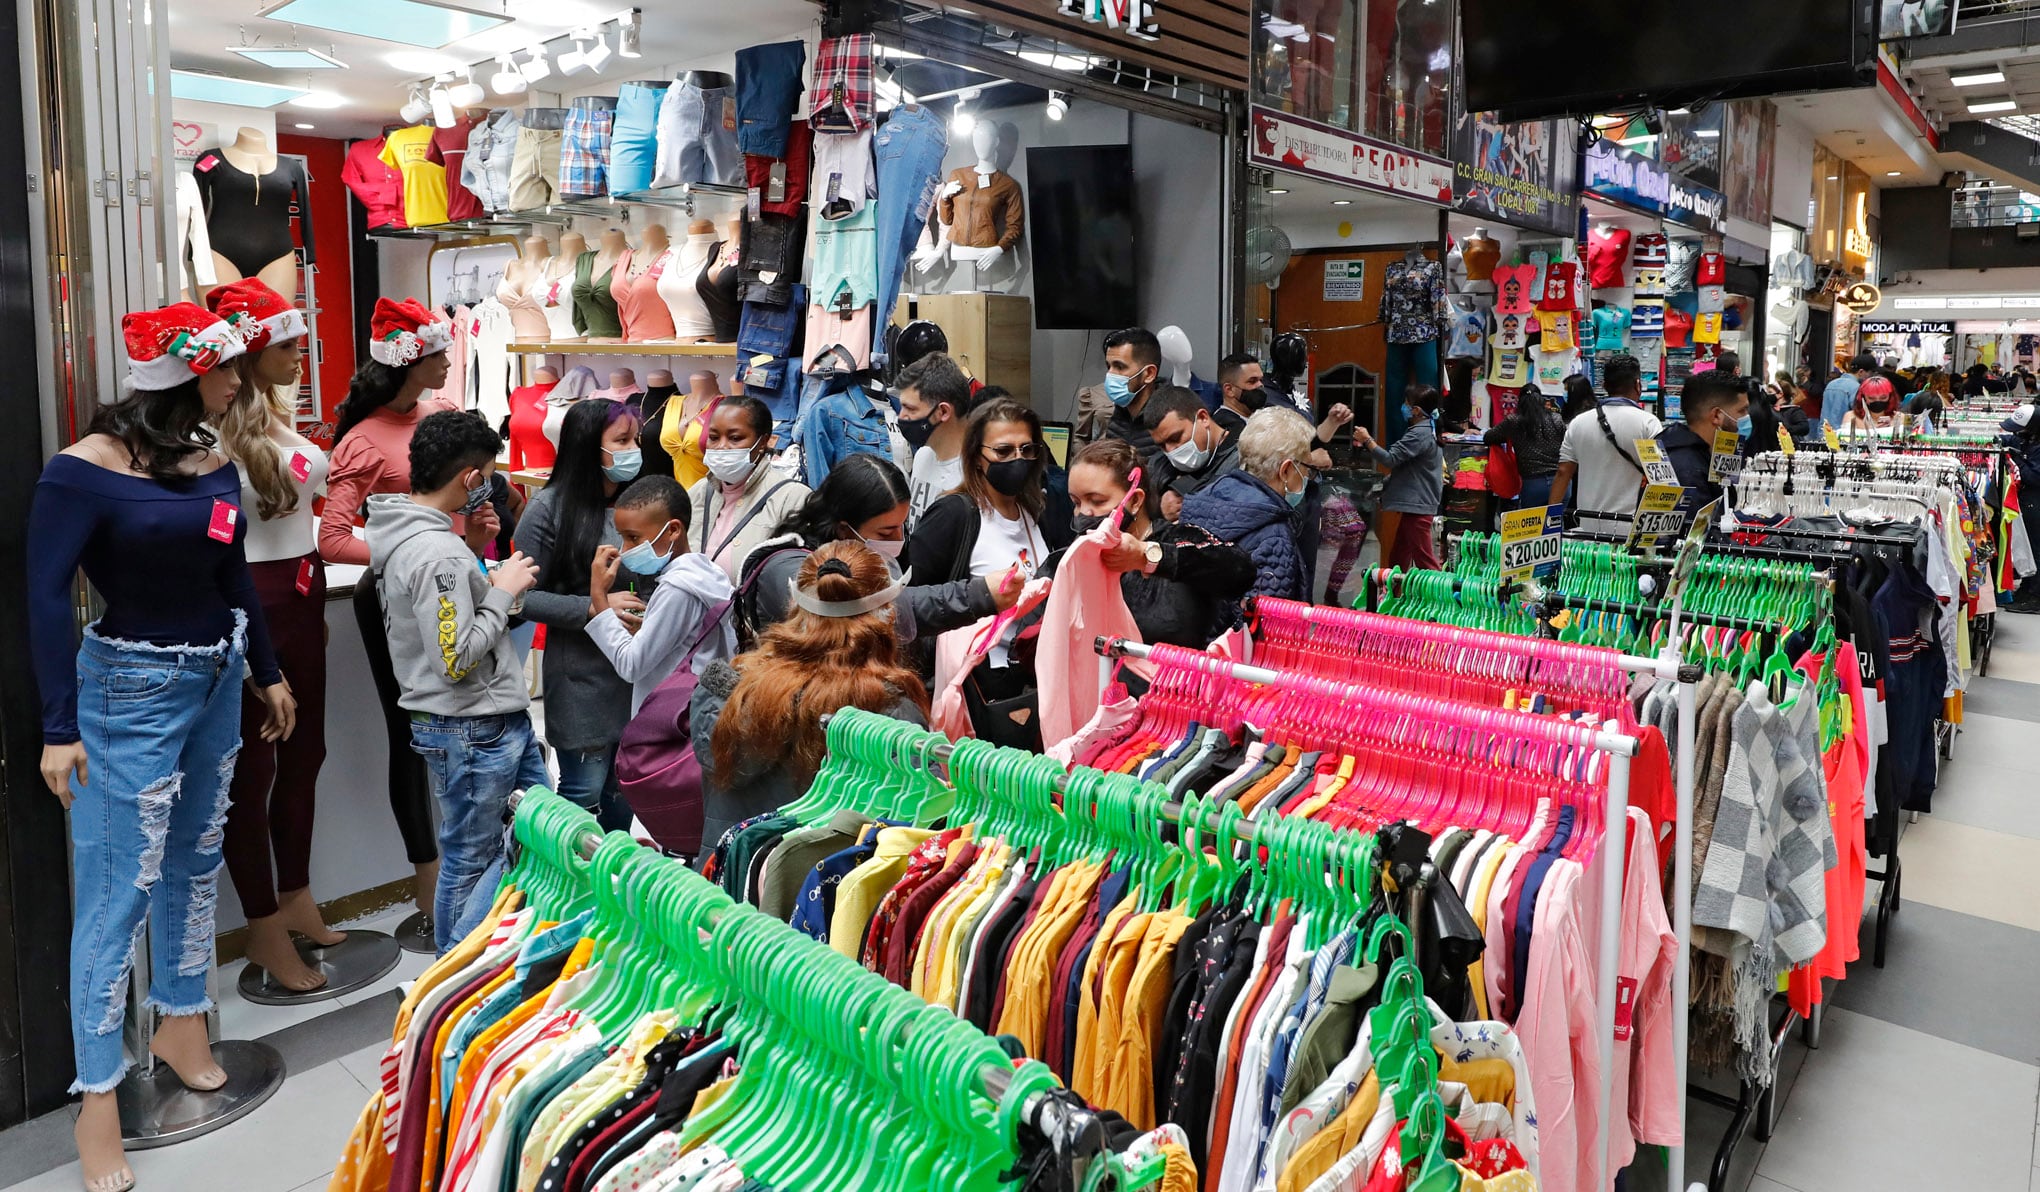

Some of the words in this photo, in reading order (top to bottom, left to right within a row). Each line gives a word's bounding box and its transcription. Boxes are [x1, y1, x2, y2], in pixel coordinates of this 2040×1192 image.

[1285, 135, 1347, 163] DISTRIBUIDORA
[1457, 162, 1472, 179] C.C.
[1473, 167, 1493, 185] GRAN
[1495, 174, 1508, 189] SAN
[1509, 178, 1538, 197] CARRERA
[1540, 188, 1547, 200] 10
[1564, 194, 1571, 207] 37
[1497, 191, 1522, 212] LOCAL
[1524, 199, 1539, 215] 1081
[1862, 323, 1895, 333] MODA
[1898, 323, 1951, 333] PUNTUAL
[1660, 492, 1677, 502] OFERTA
[1503, 519, 1520, 532] GRAN
[1521, 516, 1542, 529] OFERTA
[1859, 651, 1876, 679] RA
